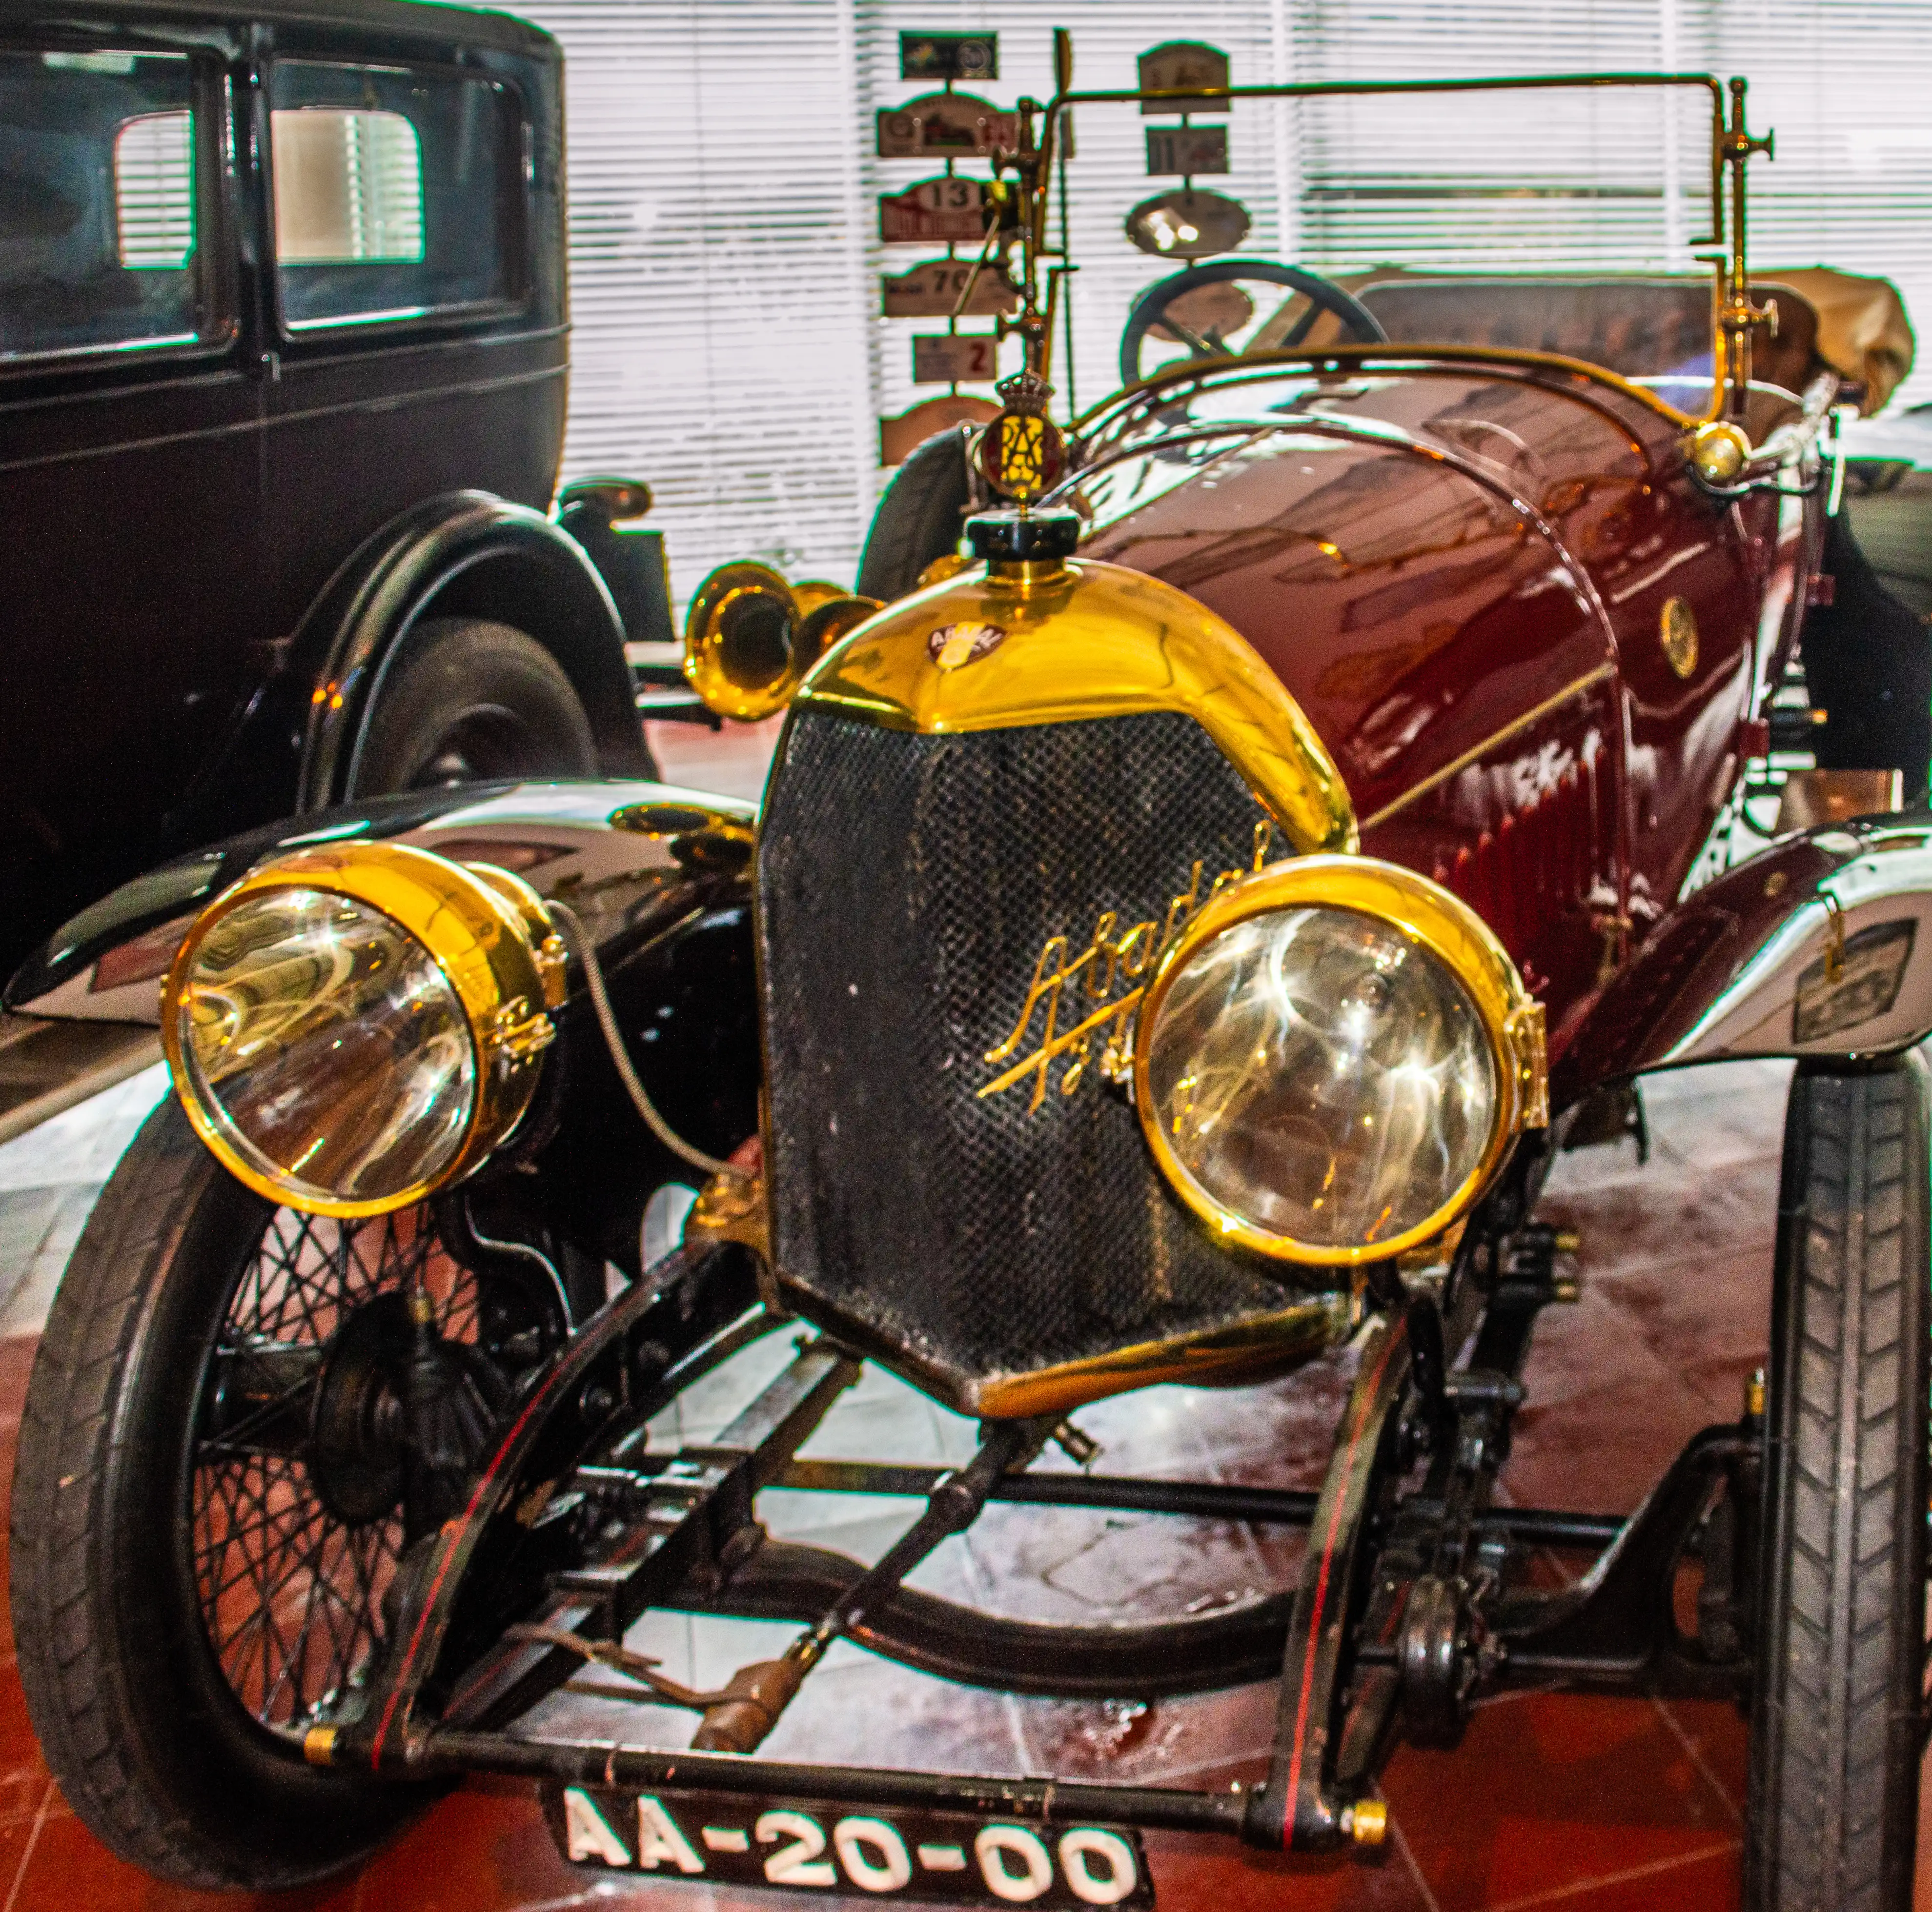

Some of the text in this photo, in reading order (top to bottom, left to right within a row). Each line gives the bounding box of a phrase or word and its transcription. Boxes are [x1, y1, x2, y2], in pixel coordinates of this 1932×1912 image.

[933, 181, 969, 208] 13
[969, 341, 989, 374] 2
[565, 1787, 1137, 1905] AA-20-00
